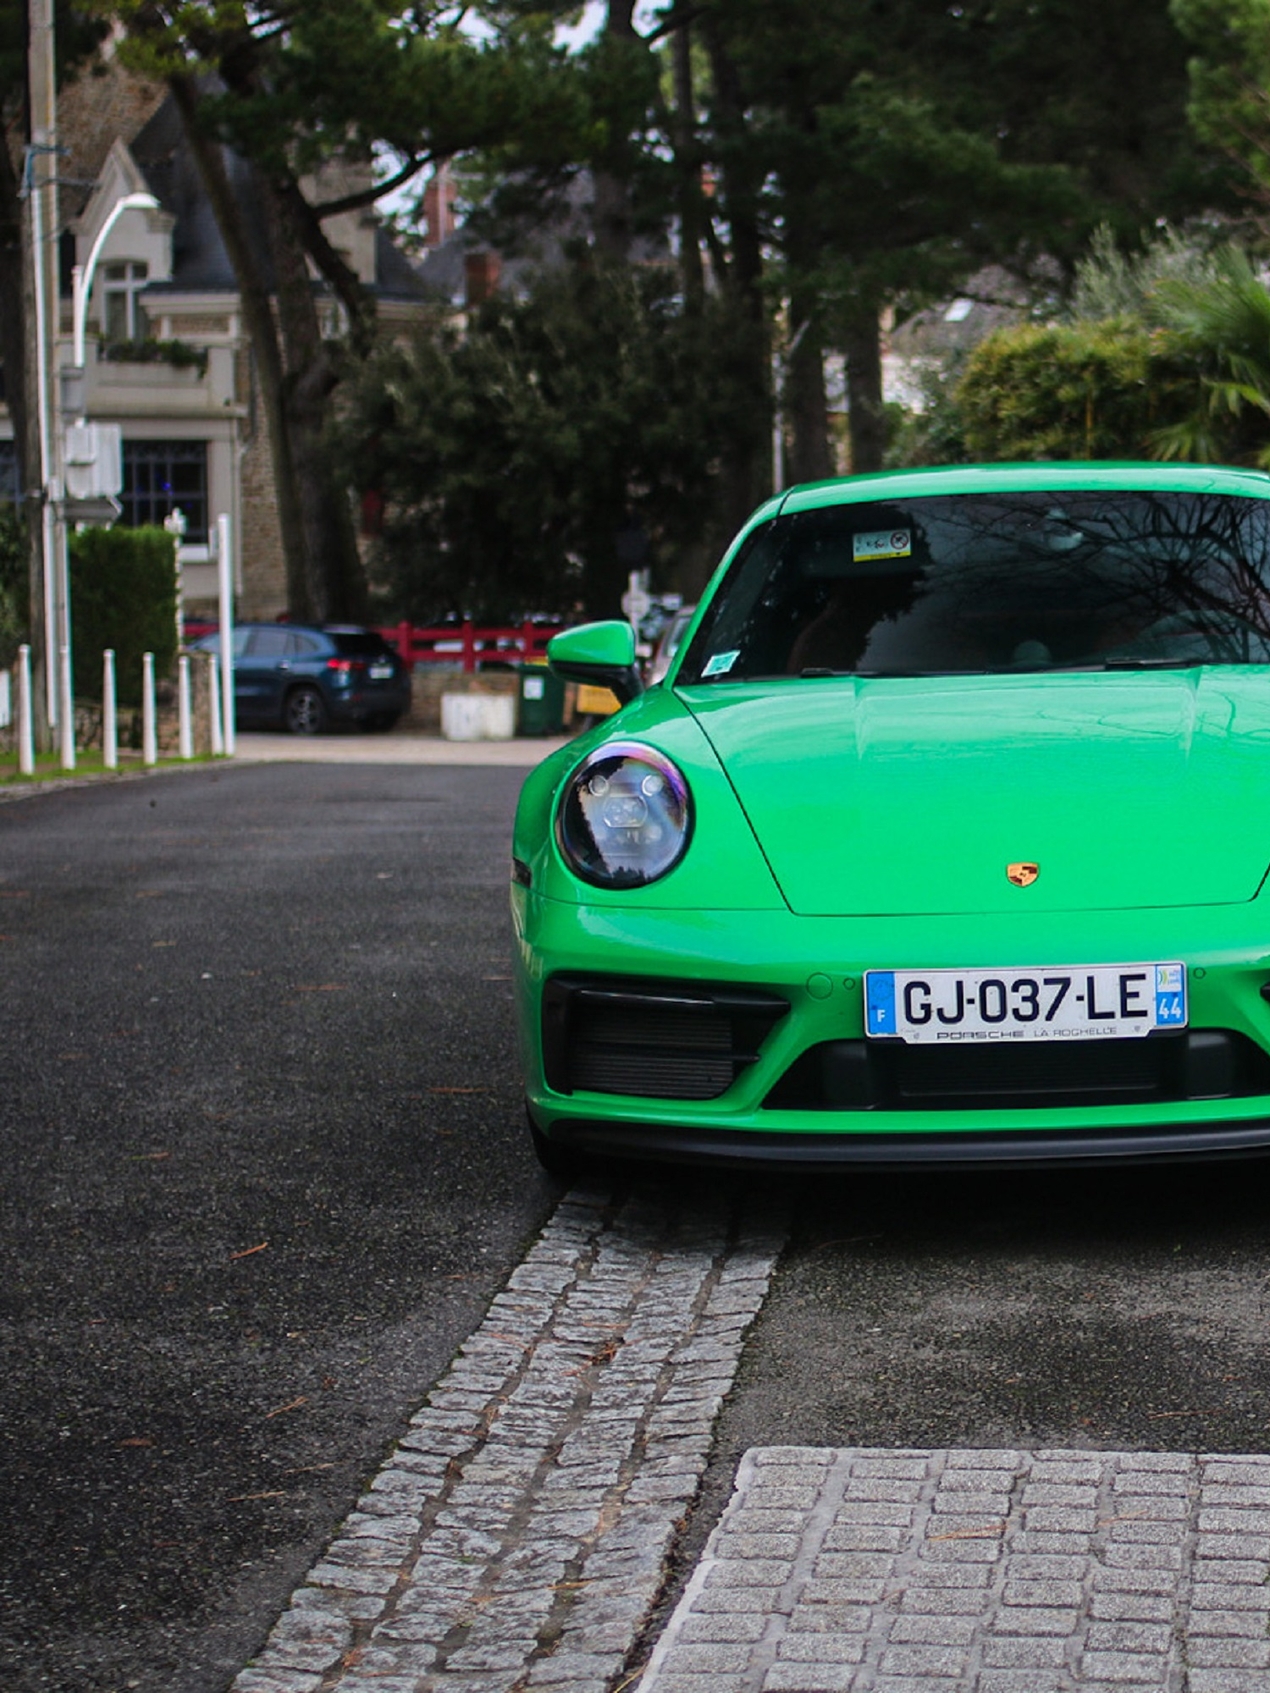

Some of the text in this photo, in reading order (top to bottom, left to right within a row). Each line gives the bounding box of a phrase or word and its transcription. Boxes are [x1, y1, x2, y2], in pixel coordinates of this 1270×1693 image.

[903, 973, 1148, 1025] GJ-037-LE
[1158, 997, 1182, 1019] 44
[876, 1009, 886, 1023] F
[936, 1026, 1118, 1041] PORSCHE LA ROCHELLE
